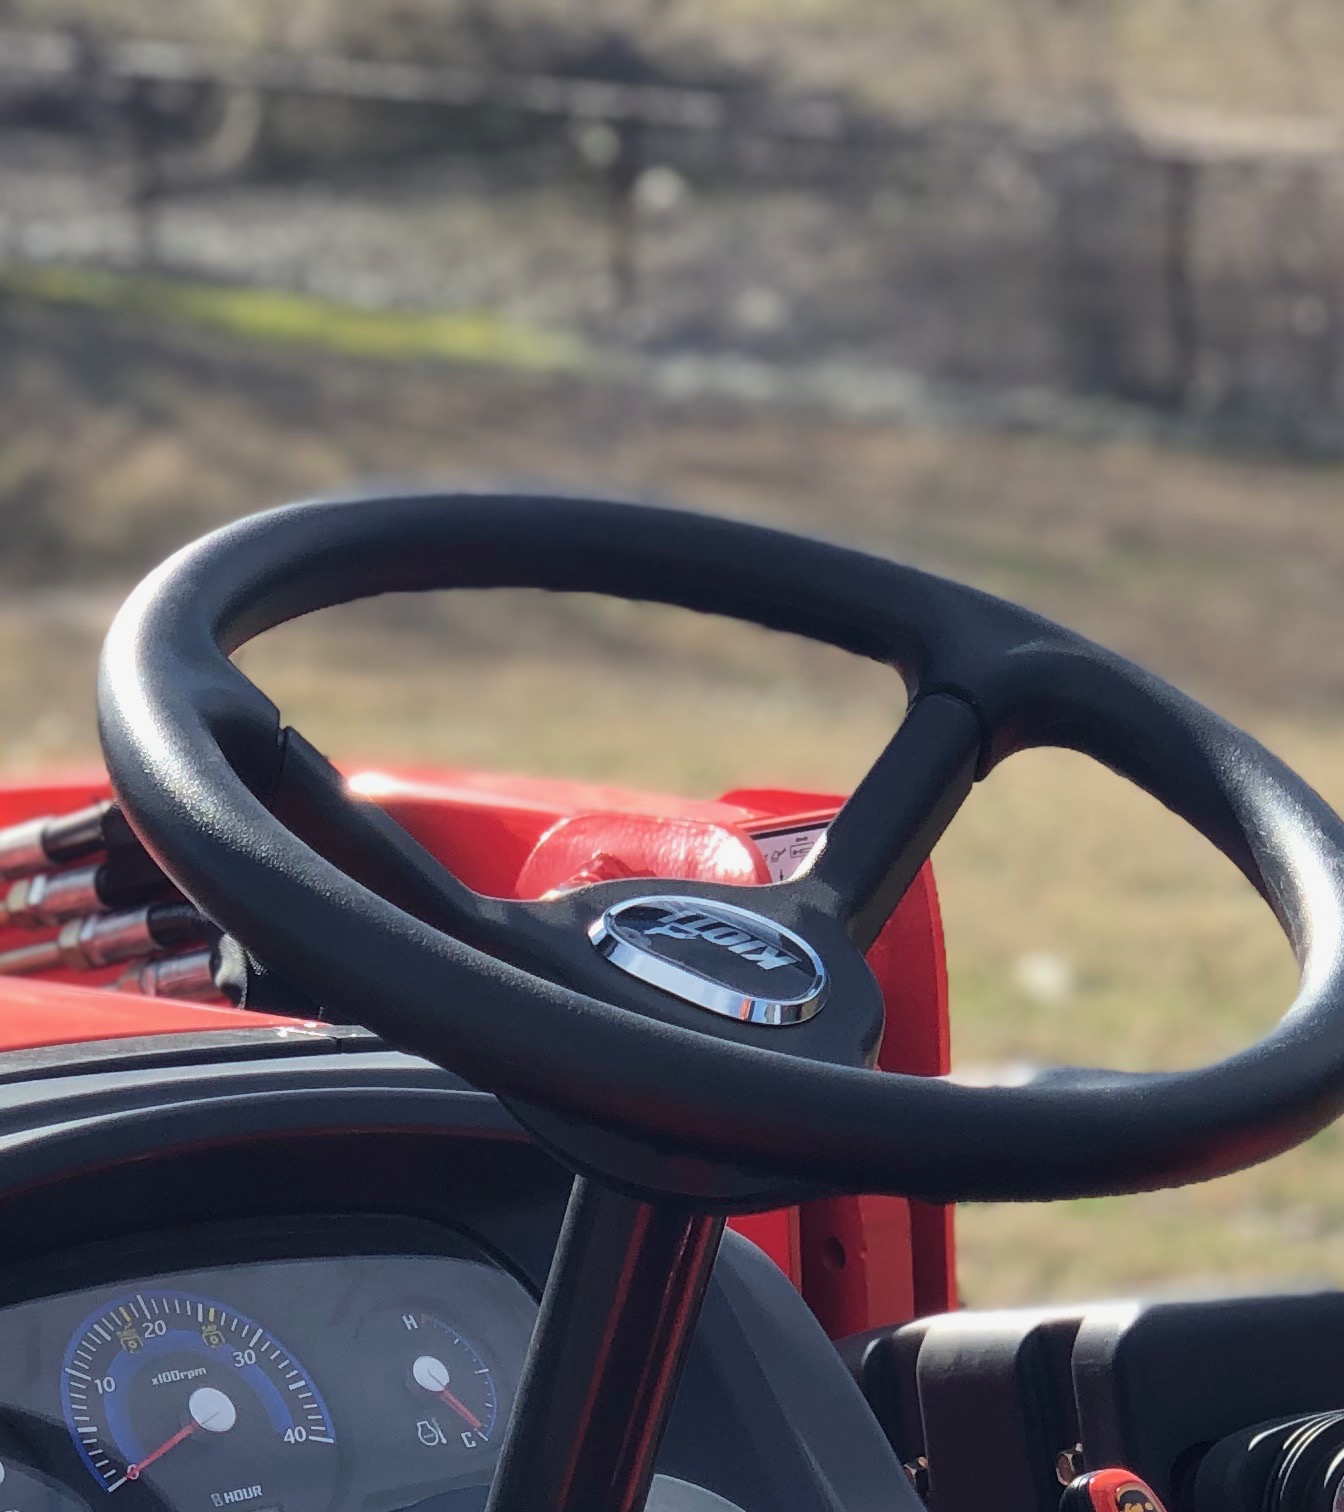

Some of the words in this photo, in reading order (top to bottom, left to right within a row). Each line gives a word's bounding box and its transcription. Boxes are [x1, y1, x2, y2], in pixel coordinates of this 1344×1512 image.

[142, 1320, 167, 1339] 20
[402, 1314, 419, 1330] H
[232, 1350, 257, 1367] 30
[94, 1376, 115, 1394] 10
[283, 1427, 306, 1444] 40
[461, 1431, 476, 1448] C
[223, 1485, 263, 1504] HOUR
